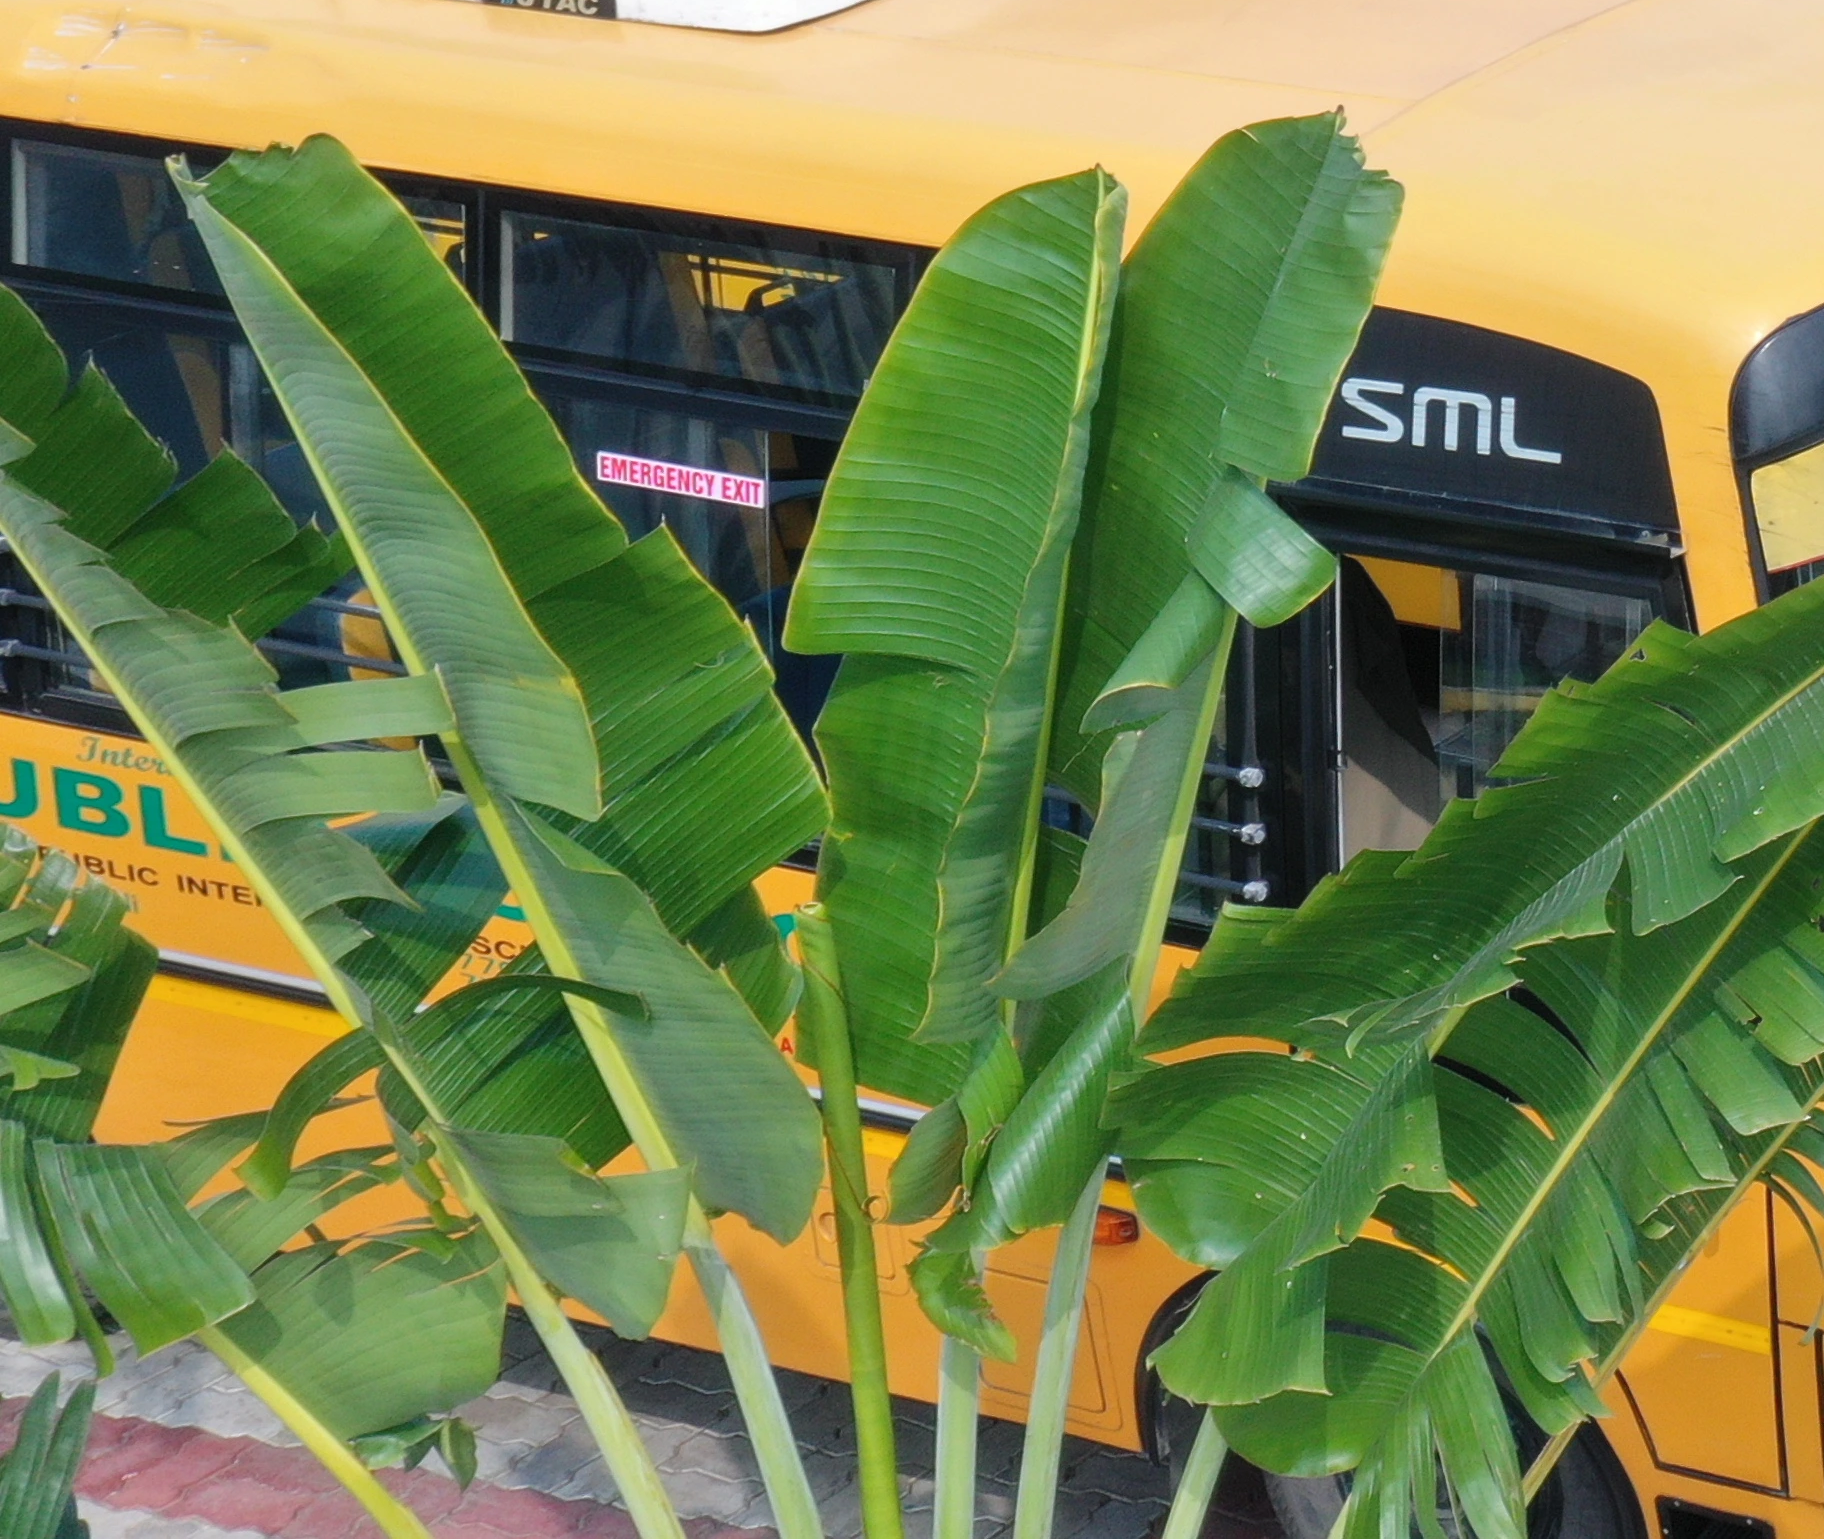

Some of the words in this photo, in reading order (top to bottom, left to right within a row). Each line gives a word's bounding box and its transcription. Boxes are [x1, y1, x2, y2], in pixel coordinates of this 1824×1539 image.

[1340, 377, 1563, 465] SML
[600, 456, 717, 497] EMERGENCY
[720, 476, 762, 505] EXIT
